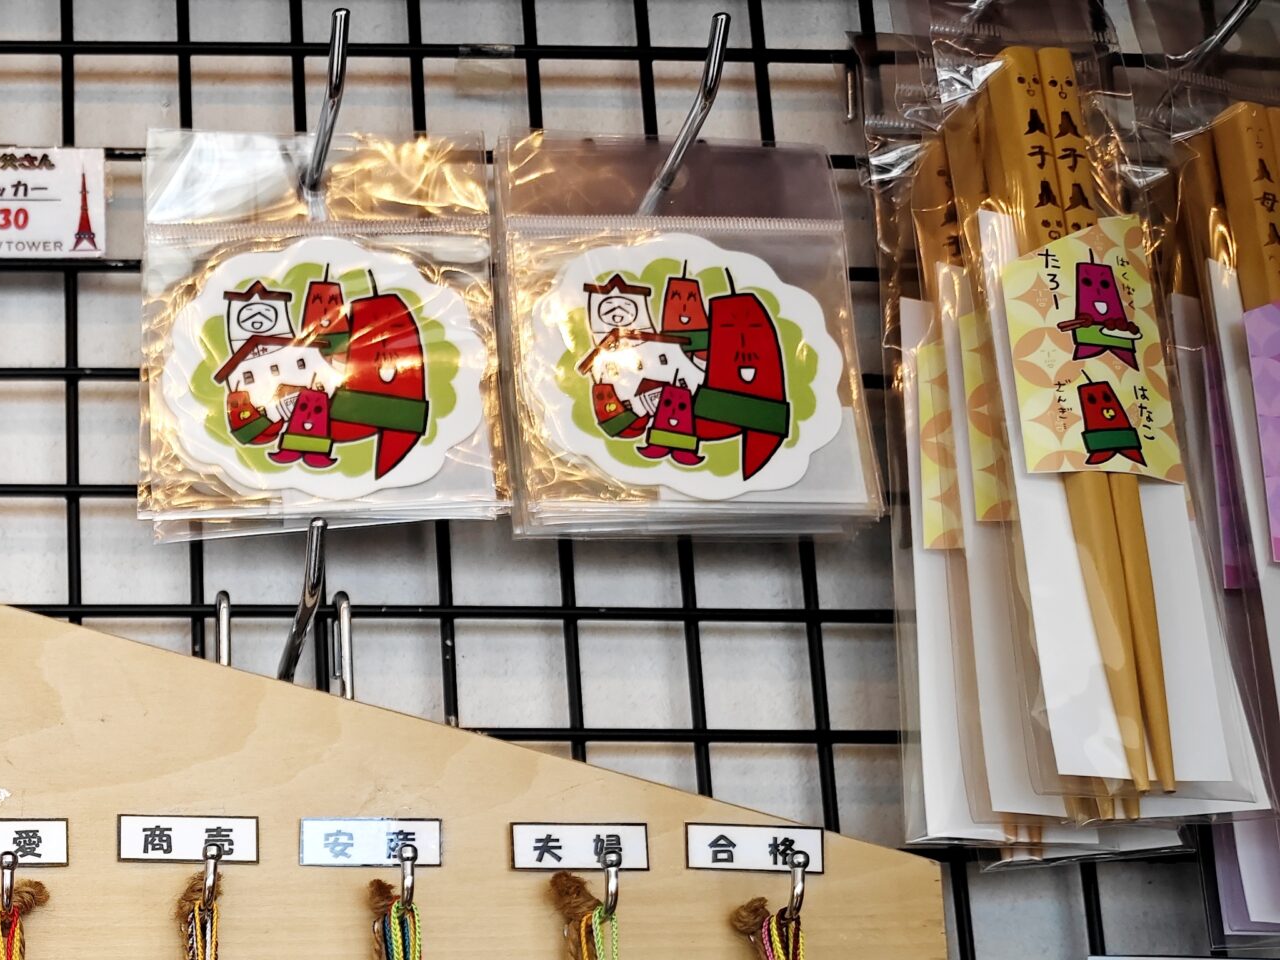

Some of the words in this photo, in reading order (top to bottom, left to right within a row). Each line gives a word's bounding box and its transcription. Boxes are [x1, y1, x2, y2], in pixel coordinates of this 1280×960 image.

[1134, 385, 1155, 441] はなこ
[142, 825, 234, 855] 商売
[708, 834, 796, 866] 合格
